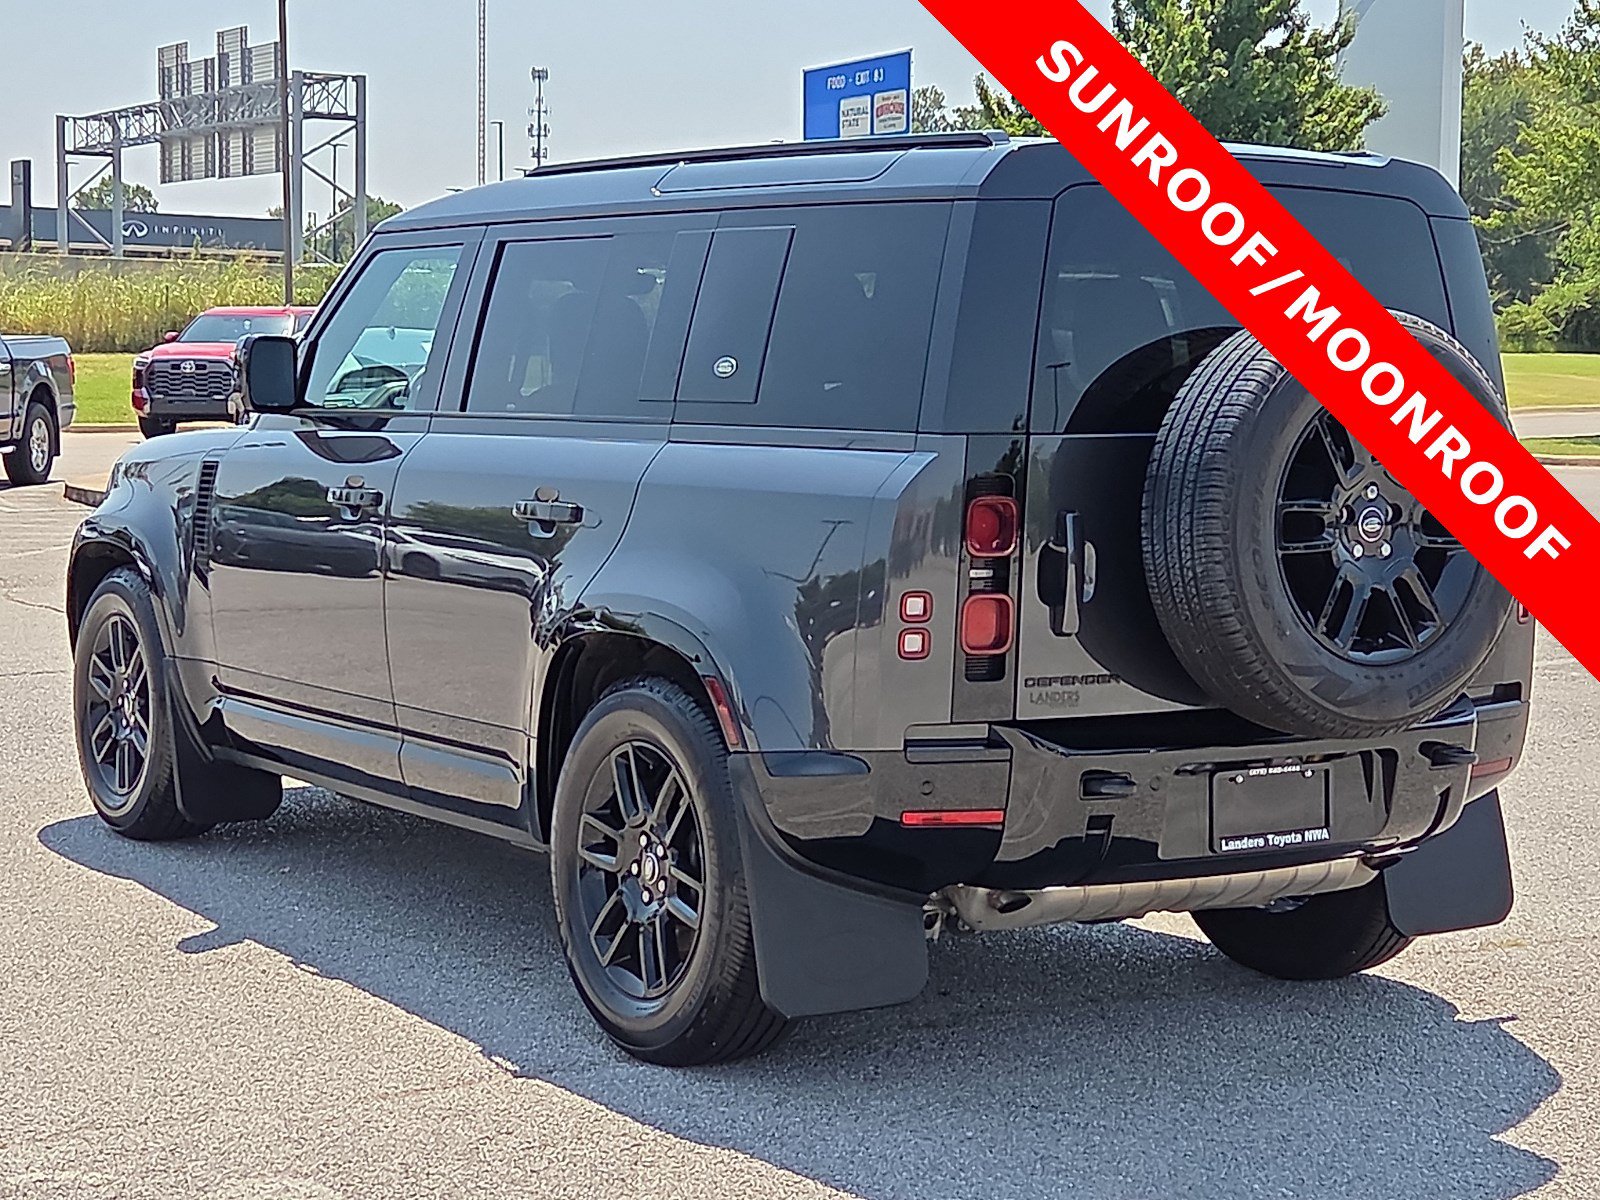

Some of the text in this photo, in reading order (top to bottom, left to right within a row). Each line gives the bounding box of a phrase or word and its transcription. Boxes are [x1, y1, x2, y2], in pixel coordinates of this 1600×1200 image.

[827, 75, 846, 90] FOOD
[855, 70, 870, 85] EXIT
[841, 106, 869, 118] NATURAL
[841, 118, 860, 129] STATE
[154, 225, 223, 236] INFINITI
[1024, 673, 1120, 688] DEFENDER
[1029, 690, 1080, 704] LANDERS
[1220, 828, 1330, 851] Landers Toyota NWA
